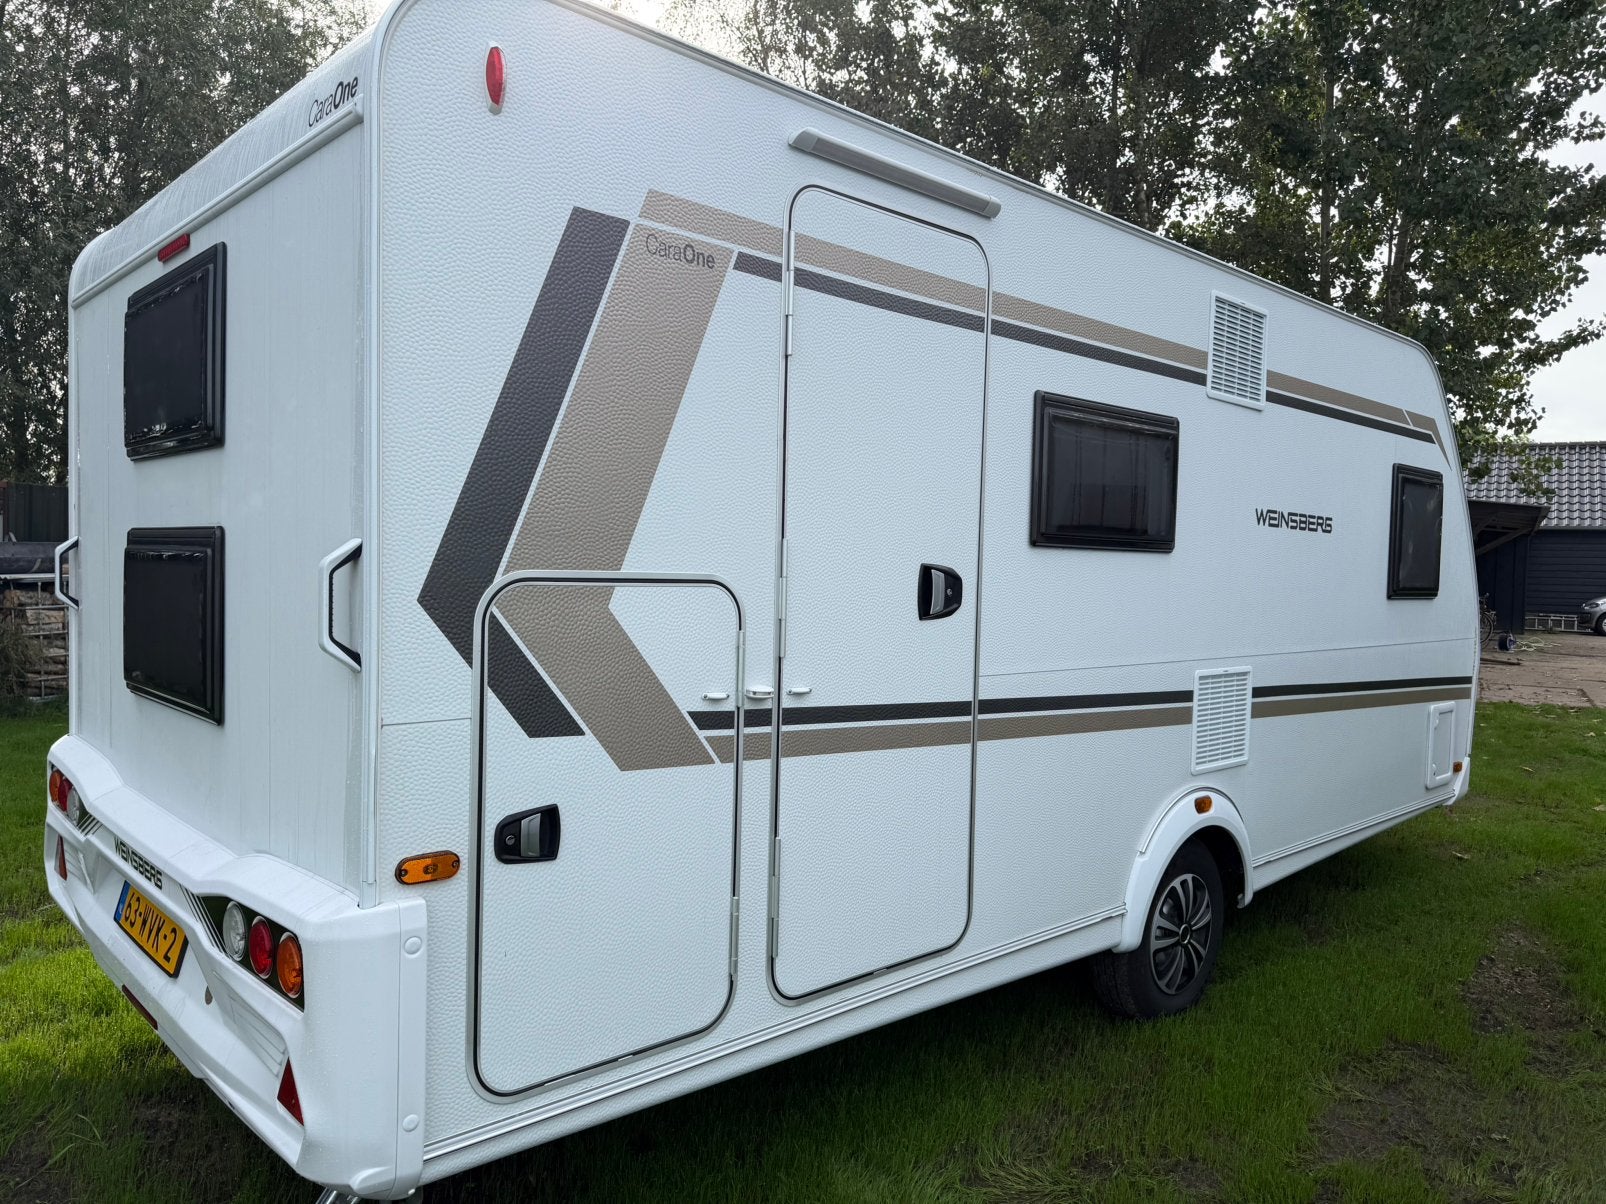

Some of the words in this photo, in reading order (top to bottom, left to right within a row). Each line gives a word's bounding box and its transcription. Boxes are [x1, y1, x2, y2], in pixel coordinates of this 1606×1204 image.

[308, 76, 358, 127] CaraOne
[646, 234, 715, 269] CaraOne
[1255, 508, 1333, 533] WEINSBERG
[114, 835, 162, 890] WEINSBERG
[124, 892, 177, 964] 63-WVK-2
